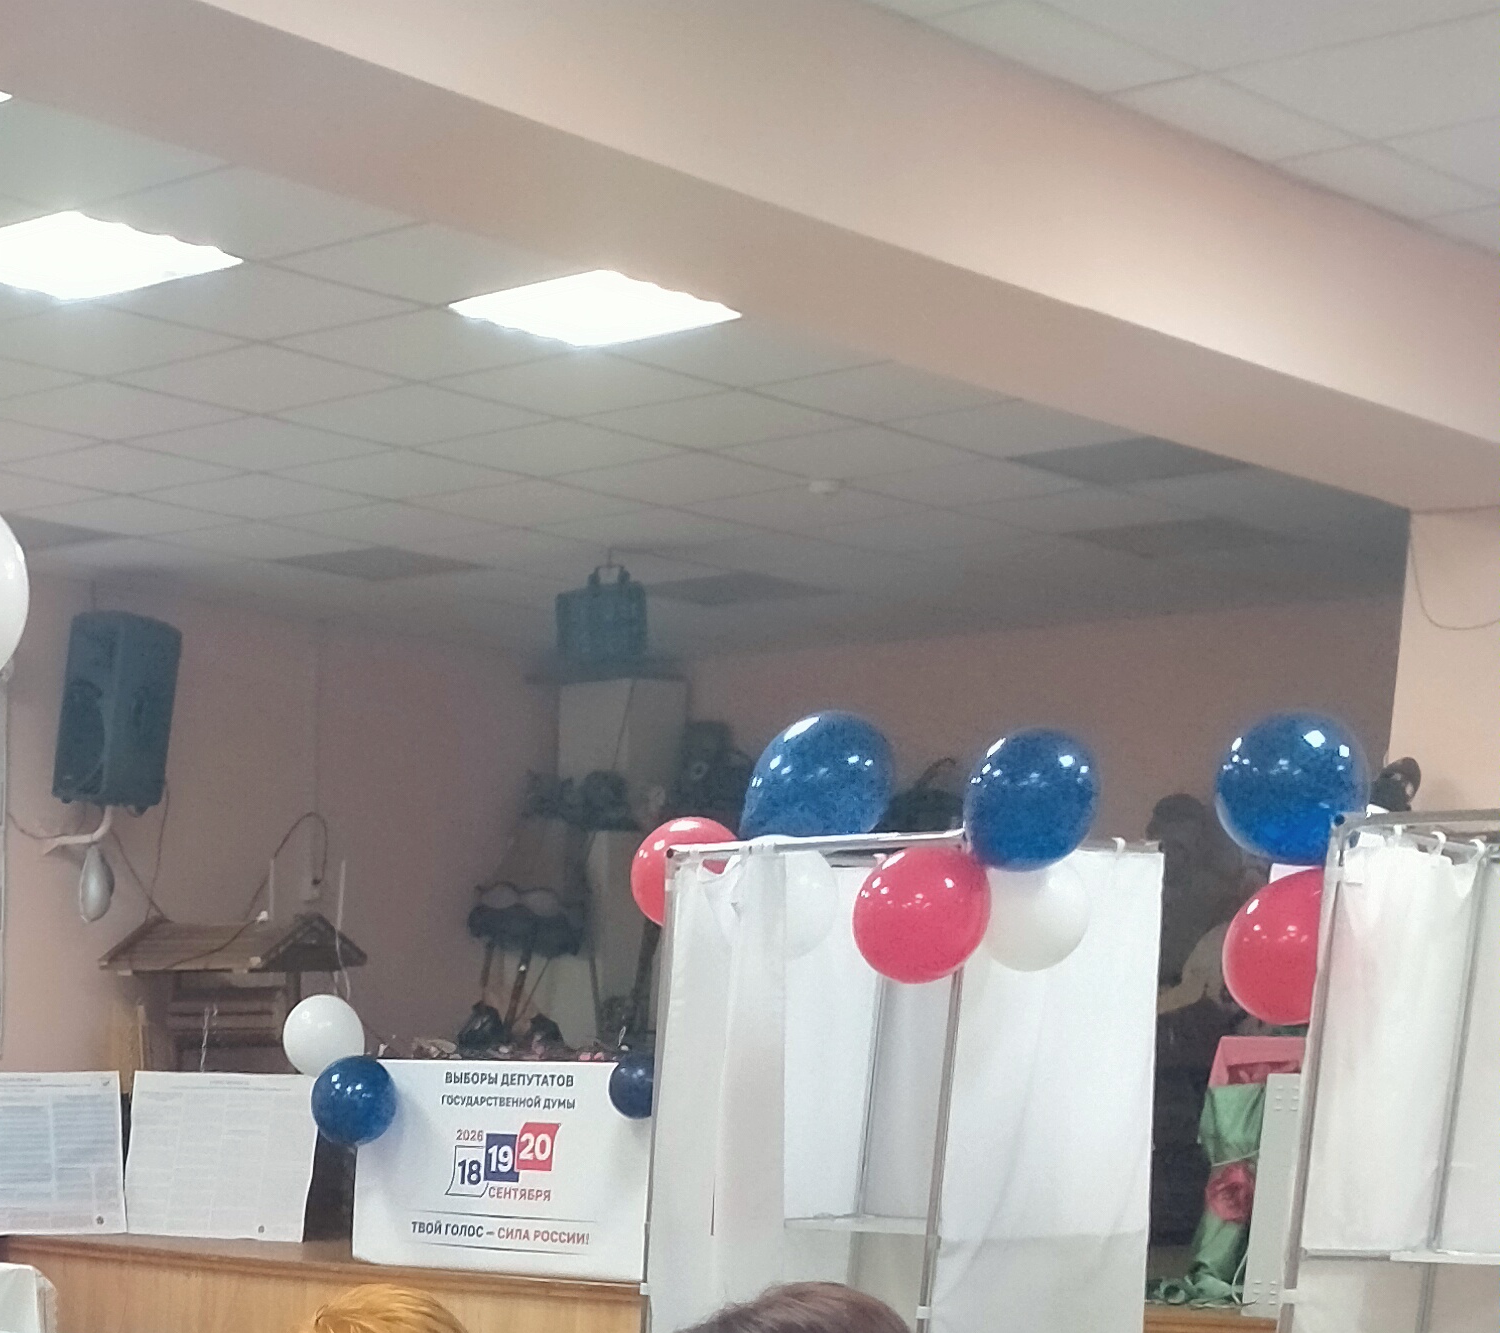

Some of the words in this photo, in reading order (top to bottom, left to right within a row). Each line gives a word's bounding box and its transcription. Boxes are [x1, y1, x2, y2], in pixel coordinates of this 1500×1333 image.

[445, 1071, 498, 1086] ВЫБОРЫ
[500, 1073, 574, 1088] ДЕПУТАТОВ
[441, 1094, 541, 1110] ГОСУДАРСТВЕННОЙ
[543, 1097, 576, 1111] ДУМЫ
[456, 1129, 484, 1142] 2026
[457, 1159, 482, 1185] 18
[487, 1144, 514, 1173] 19
[518, 1132, 552, 1161] 20
[488, 1186, 551, 1202] СЕНТЯБРЯ
[411, 1220, 443, 1236] ТВОЙ
[444, 1223, 484, 1239] ГОЛОС
[497, 1227, 531, 1242] СИЛА
[534, 1230, 590, 1246] РОССИИ!
